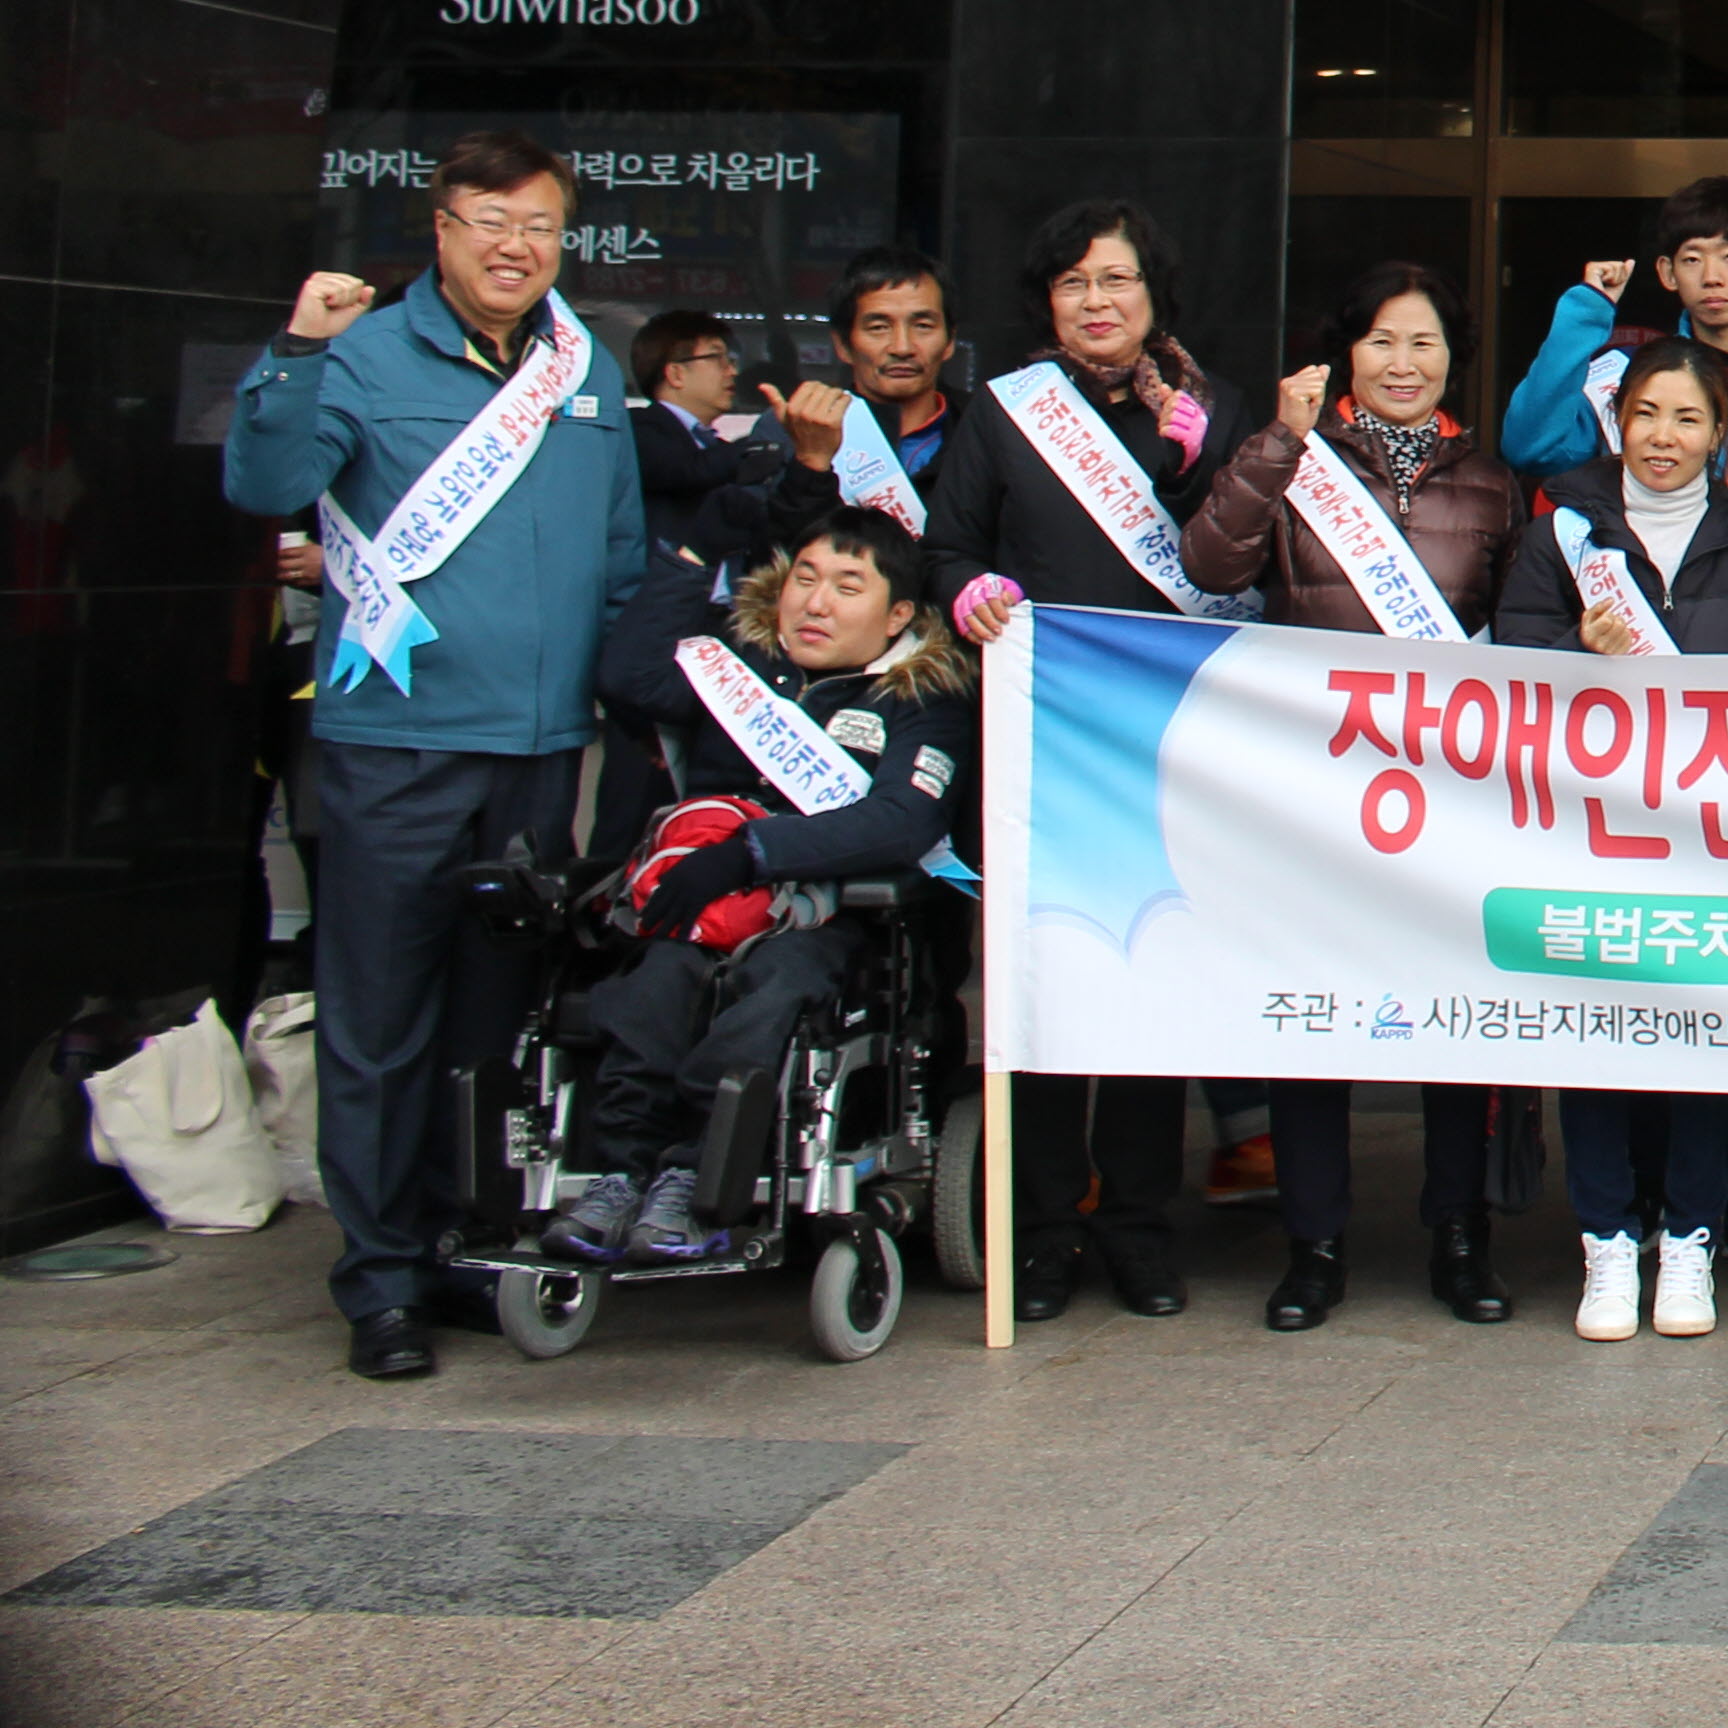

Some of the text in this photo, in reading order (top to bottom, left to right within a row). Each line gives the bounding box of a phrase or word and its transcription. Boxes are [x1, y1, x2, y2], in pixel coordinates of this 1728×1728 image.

[686, 152, 820, 192] 차올리다
[426, 431, 518, 524] 장애인에게
[1027, 385, 1156, 532] 장애인전용주차구역
[747, 702, 832, 790] 장애인에게
[1261, 991, 1339, 1033] 주관
[1370, 1029, 1414, 1040] KAPPD
